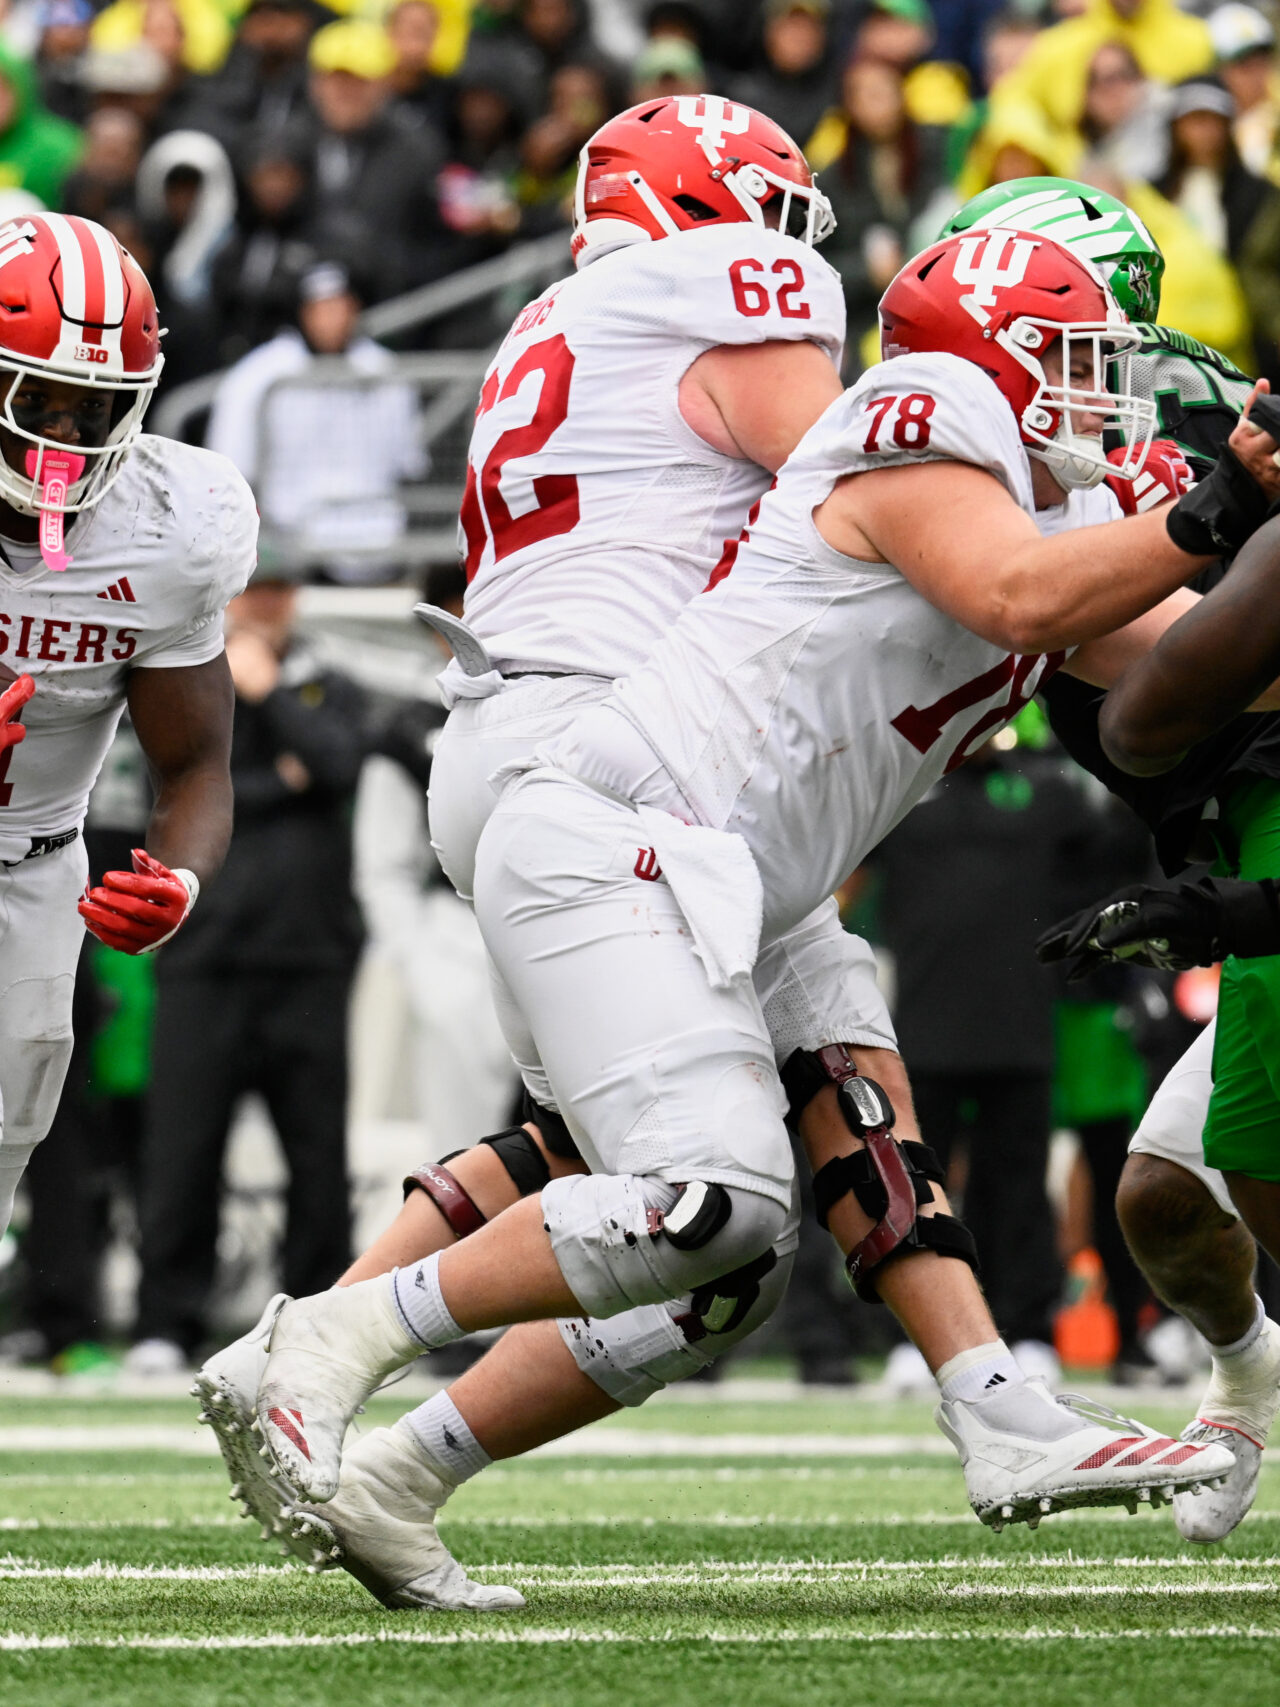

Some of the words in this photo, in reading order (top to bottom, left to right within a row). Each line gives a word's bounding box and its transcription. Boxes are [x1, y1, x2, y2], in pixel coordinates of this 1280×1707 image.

[728, 257, 812, 320] 62
[862, 392, 937, 454] 78
[46, 485, 63, 547] BATLE
